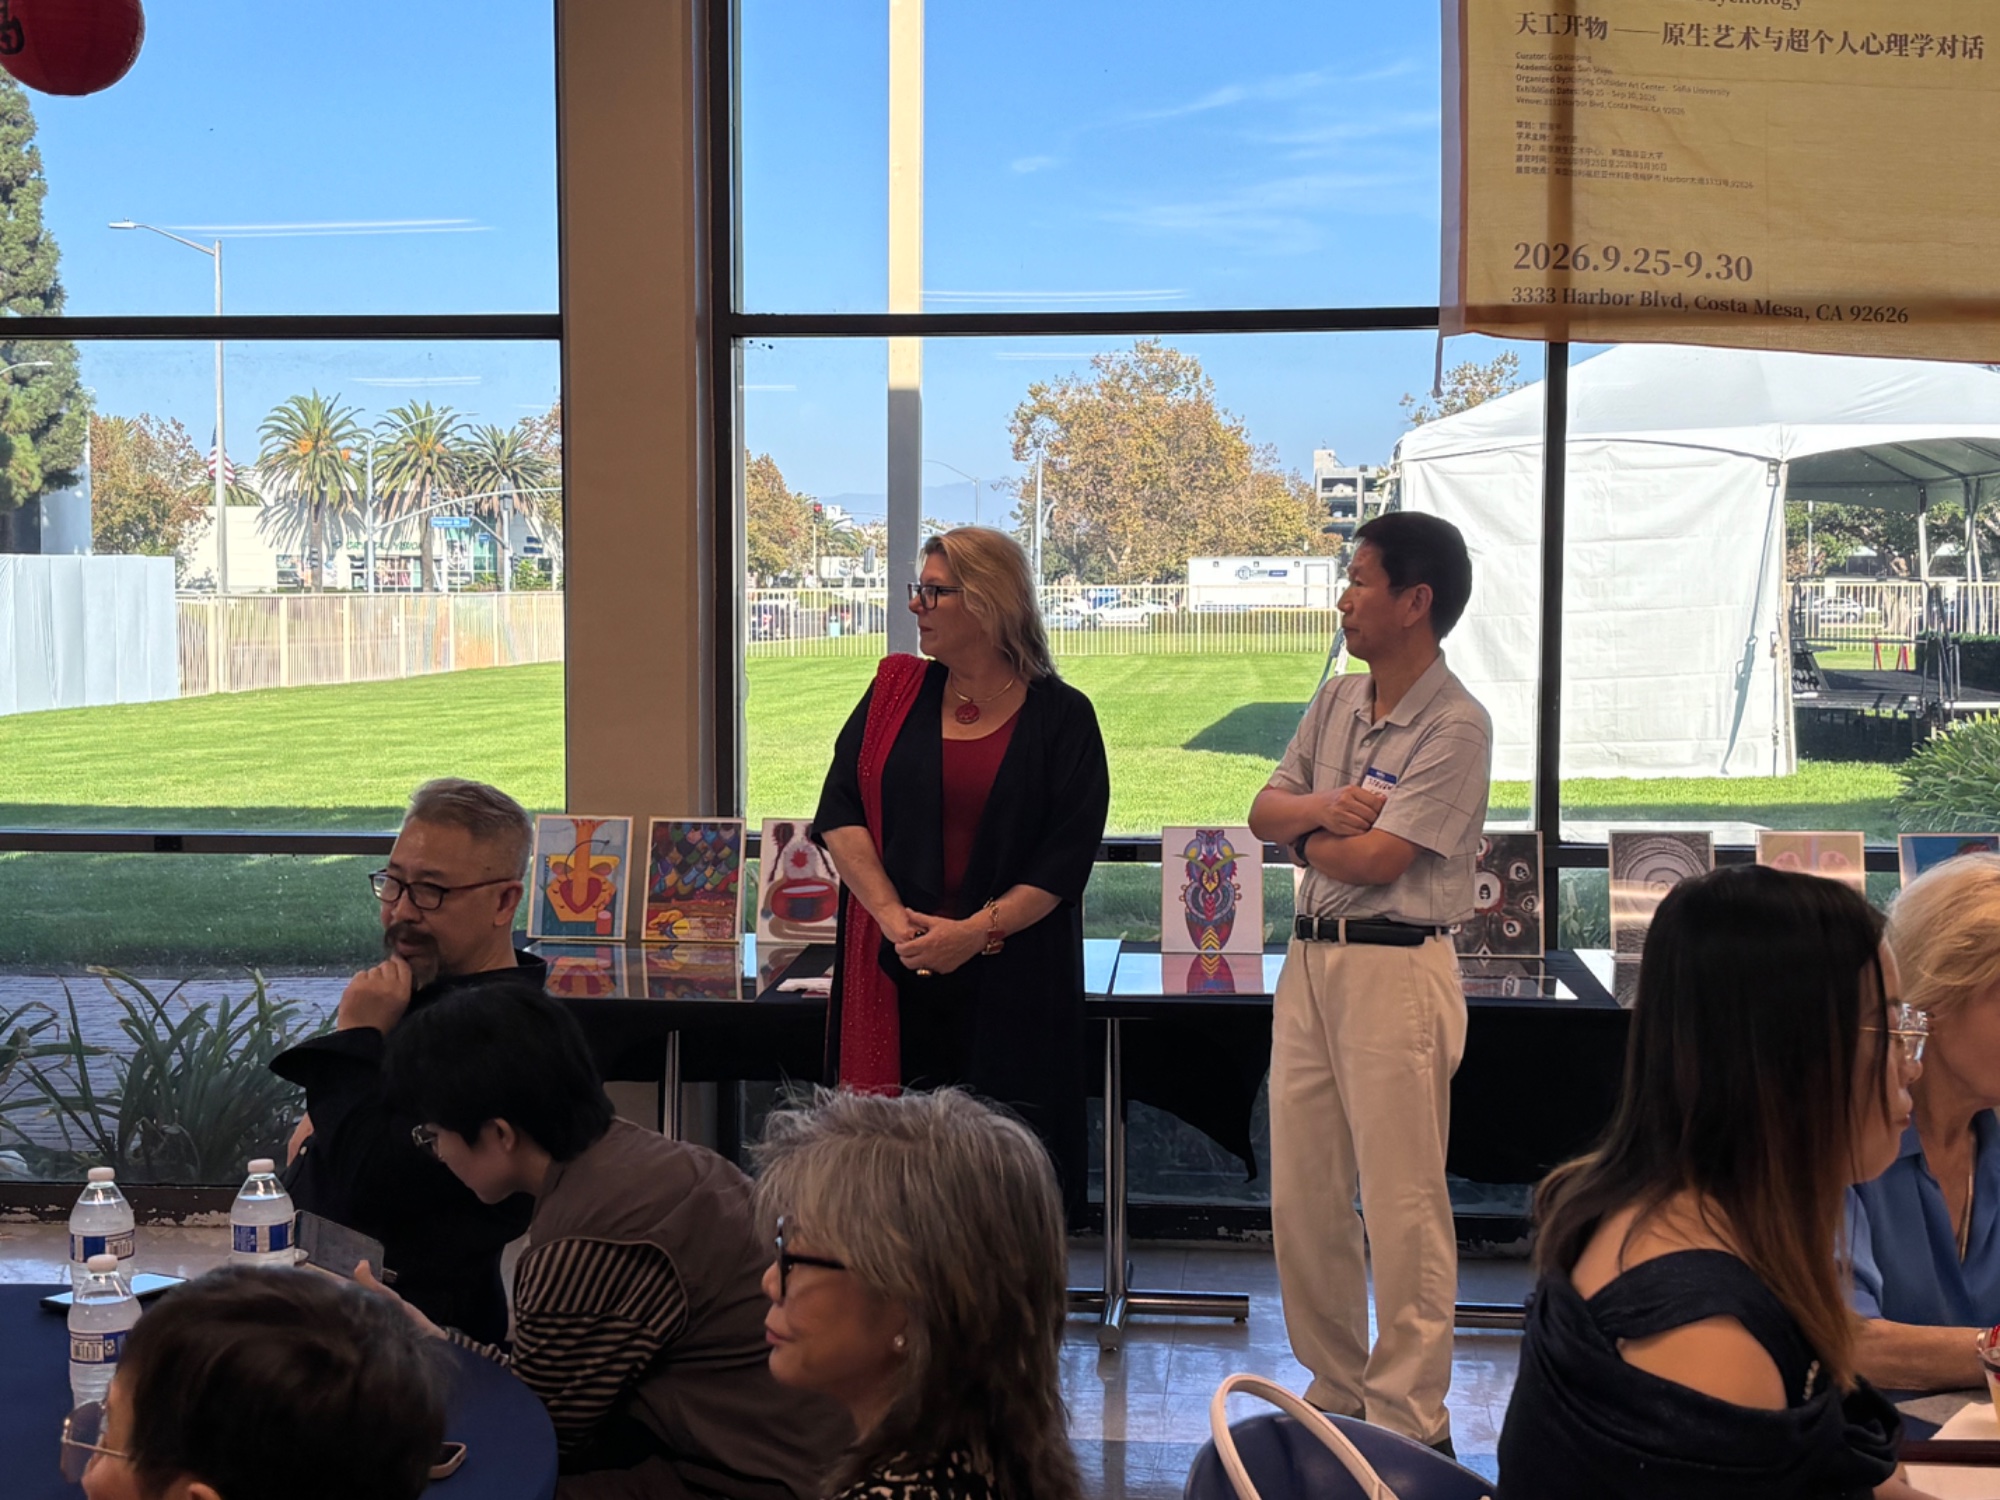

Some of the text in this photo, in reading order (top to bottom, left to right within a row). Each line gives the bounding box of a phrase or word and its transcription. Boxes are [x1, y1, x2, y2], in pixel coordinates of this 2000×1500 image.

[1513, 242, 1753, 282] 2026.9.25-9.30
[1511, 286, 1909, 323] 3333 Harbor Blvd, Costa Mesa, CA 92626
